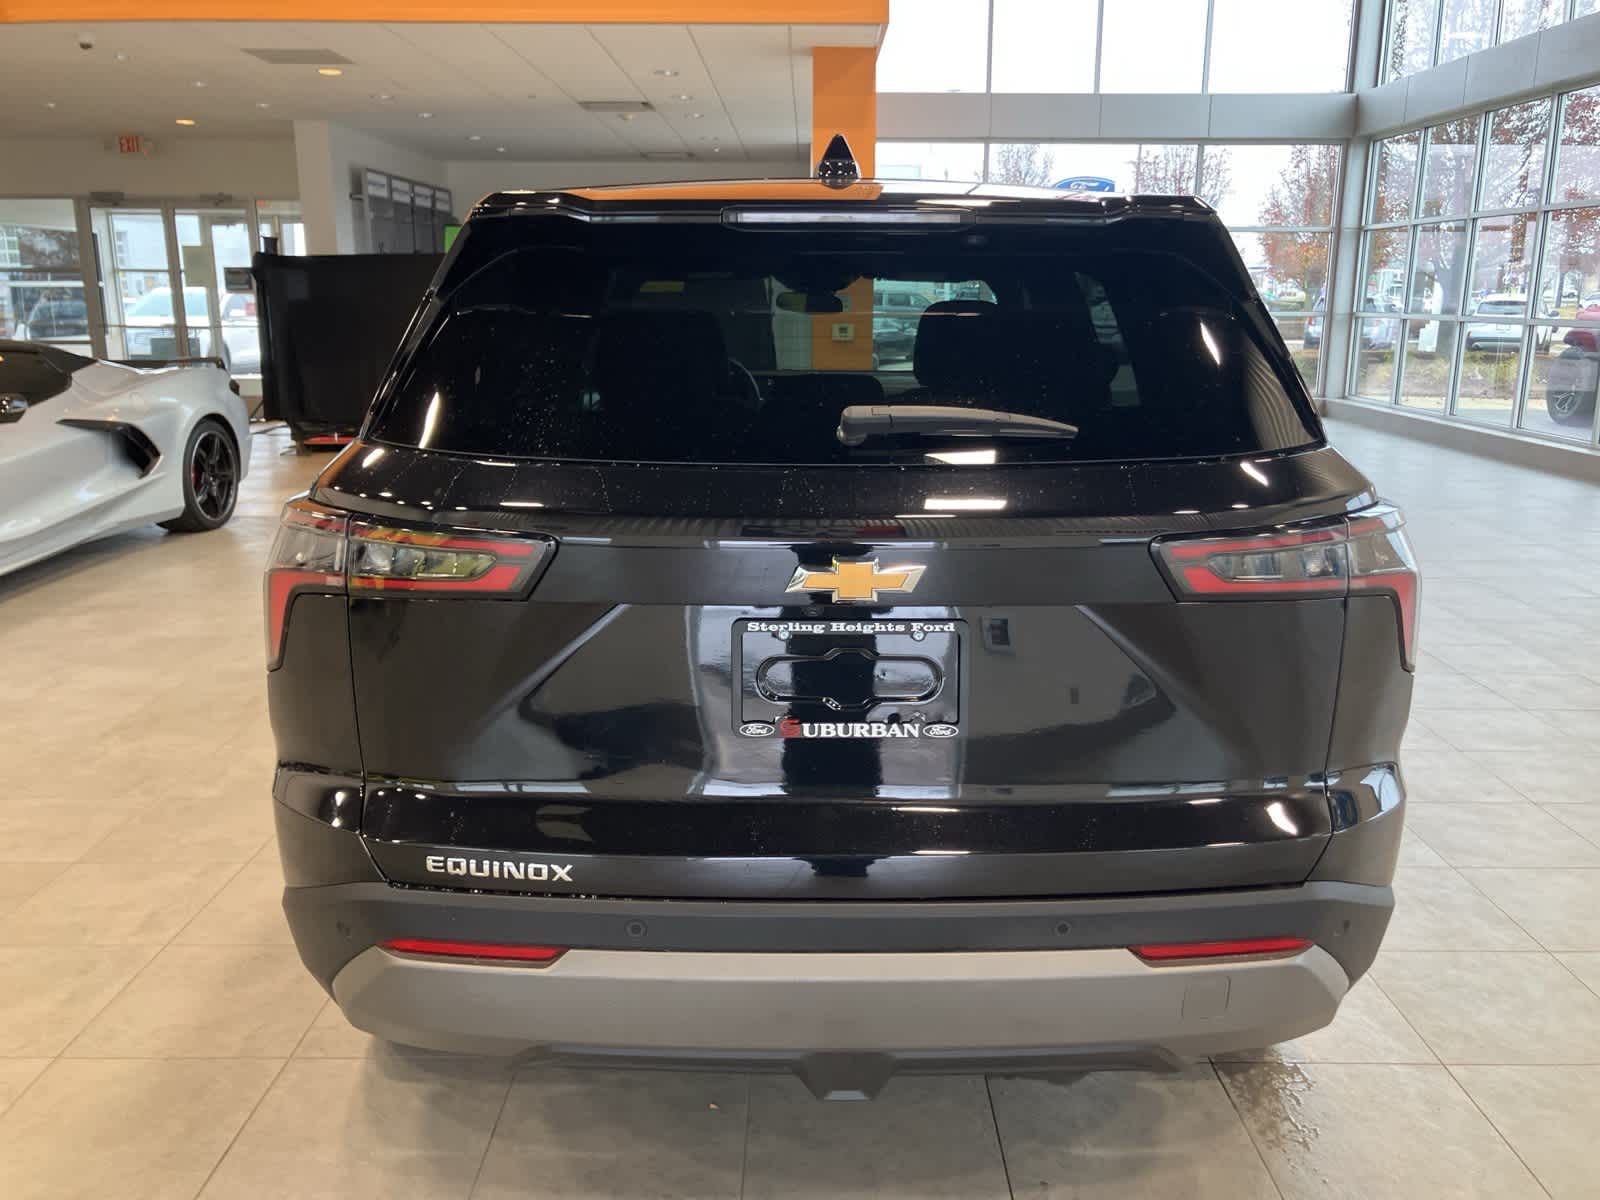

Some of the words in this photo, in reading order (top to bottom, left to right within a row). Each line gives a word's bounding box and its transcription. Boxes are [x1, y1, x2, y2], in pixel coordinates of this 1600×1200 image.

[118, 136, 141, 153] EXIT
[747, 622, 825, 634] Sterling
[830, 622, 905, 634] Heights
[911, 622, 955, 633] Ford
[742, 724, 771, 735] Ford
[780, 719, 920, 738] SUBURBAN
[926, 725, 956, 737] Ford
[426, 855, 573, 882] EQUINOX
